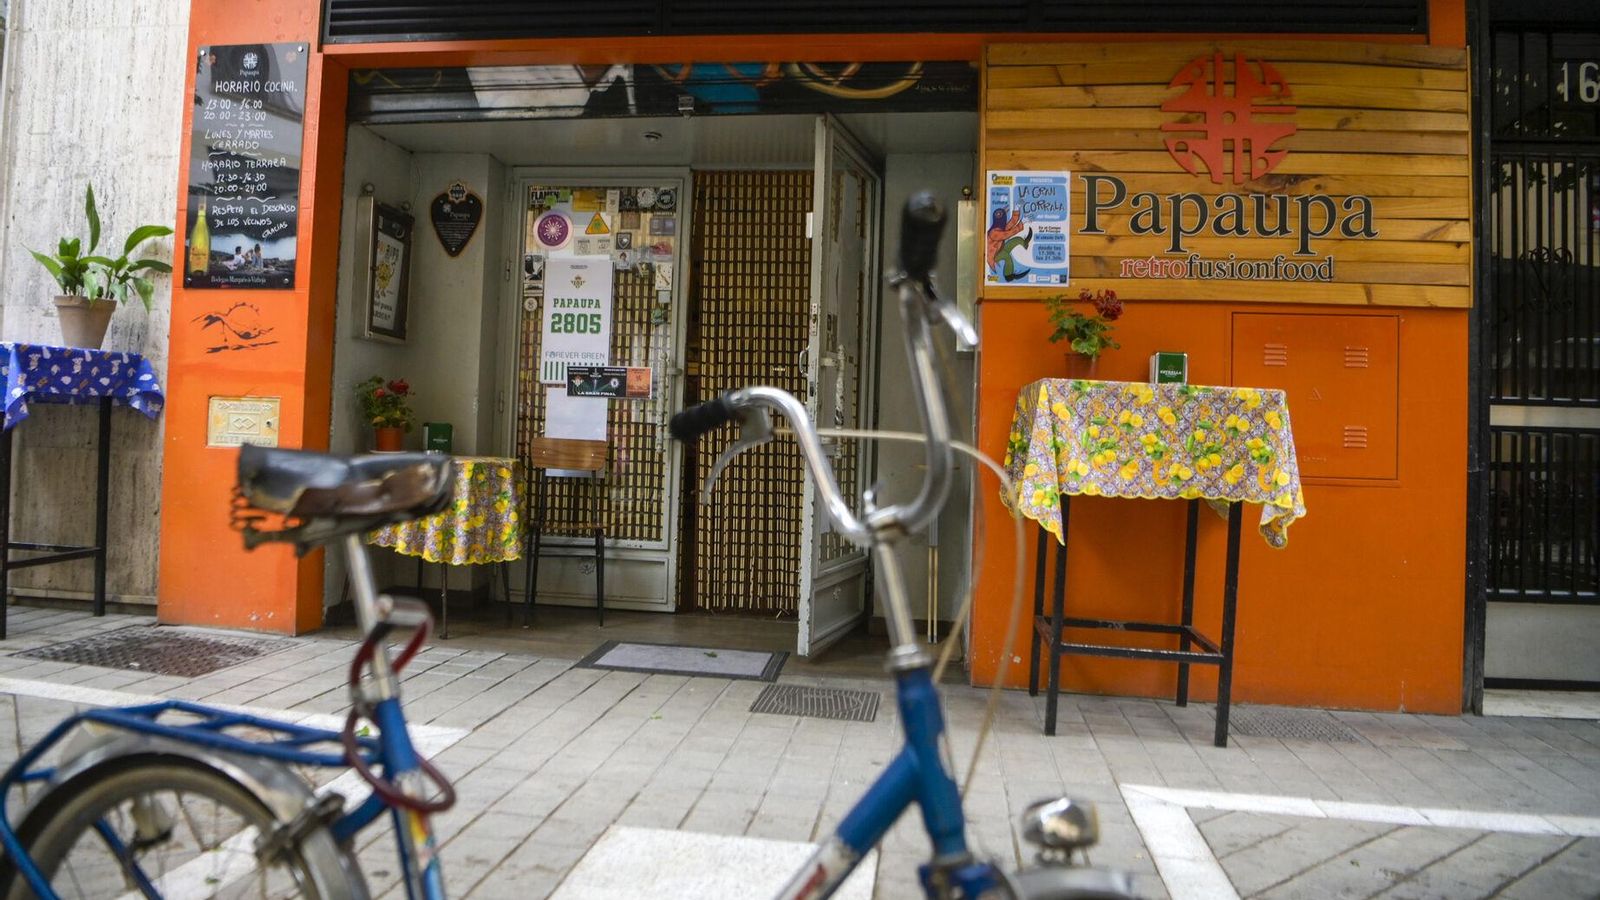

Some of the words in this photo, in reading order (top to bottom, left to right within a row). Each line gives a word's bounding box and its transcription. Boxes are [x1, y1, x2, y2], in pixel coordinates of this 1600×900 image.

[215, 80, 261, 93] HORARIO
[1561, 61, 1600, 103] 16
[204, 128, 232, 139] LUNES
[236, 129, 243, 139] Y
[243, 128, 274, 139] MARTES
[211, 139, 260, 150] CERRADO
[201, 160, 241, 172] HORARIO
[1032, 186, 1056, 199] GRAN
[212, 204, 244, 216] RESPETA
[250, 207, 259, 215] EL
[1022, 199, 1065, 214] CORRALA
[1078, 174, 1379, 256] Papaupa
[214, 219, 225, 228] DE
[227, 217, 240, 227] LOS
[243, 216, 273, 227] VECINOS
[1119, 252, 1335, 282] retrofusionfood
[553, 297, 602, 309] PAPAUPA
[550, 312, 602, 334] 2805
[581, 351, 605, 360] GREEN
